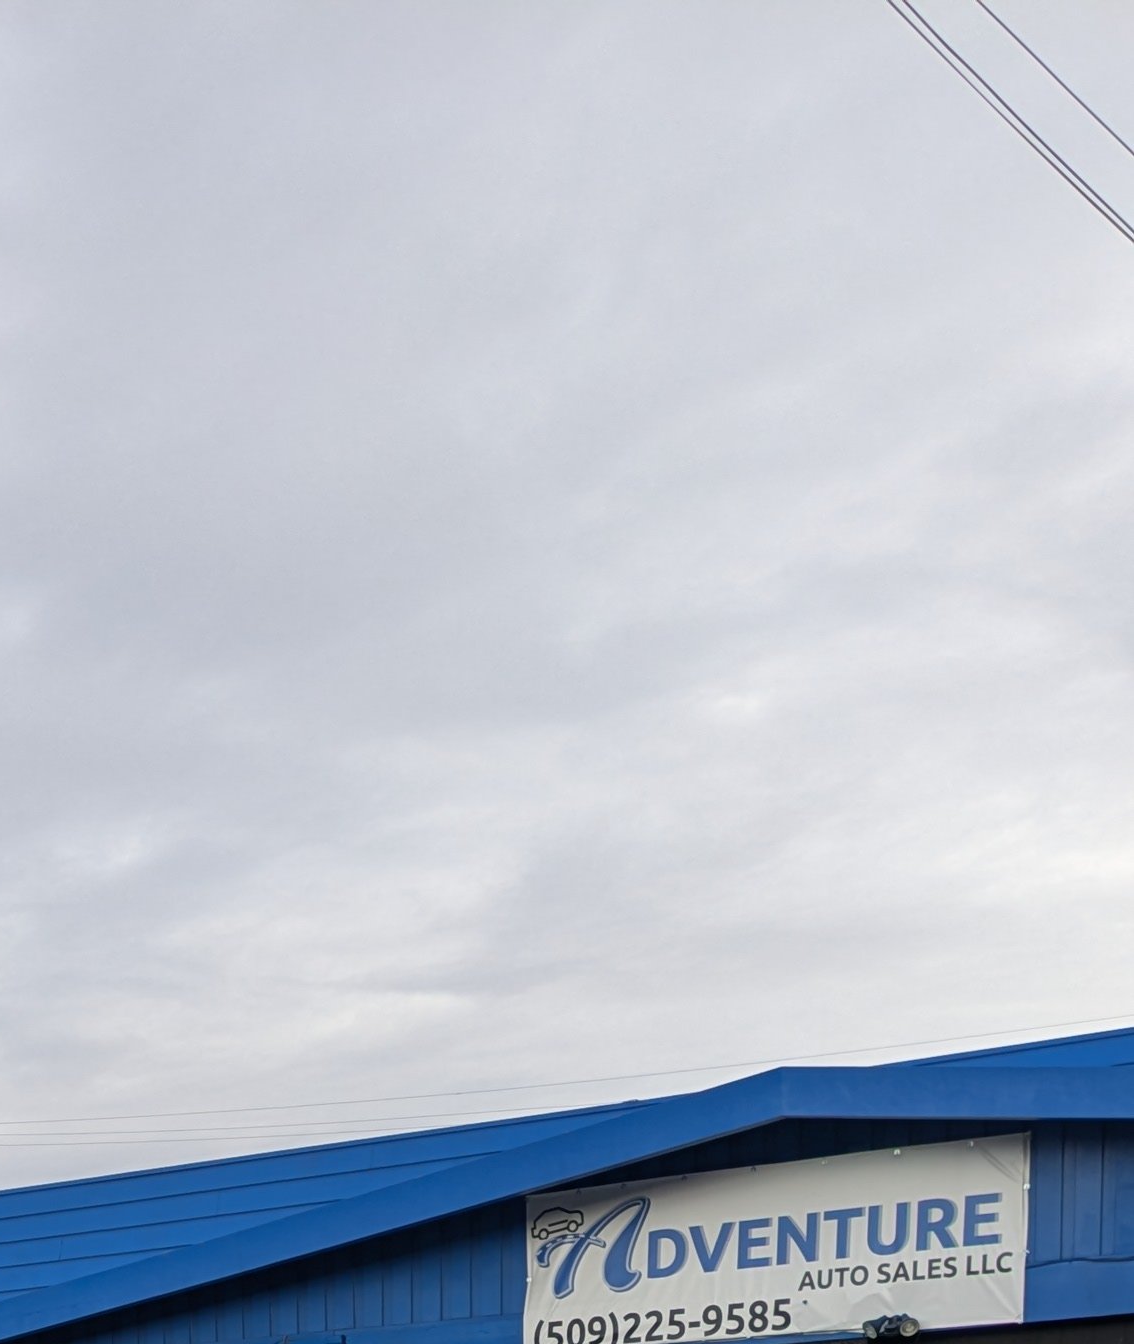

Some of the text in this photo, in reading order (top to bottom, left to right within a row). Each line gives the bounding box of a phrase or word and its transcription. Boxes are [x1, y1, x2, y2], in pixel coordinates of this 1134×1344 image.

[534, 1192, 1003, 1300] ADVENTURE
[798, 1251, 1013, 1292] AUTO SALES LLC
